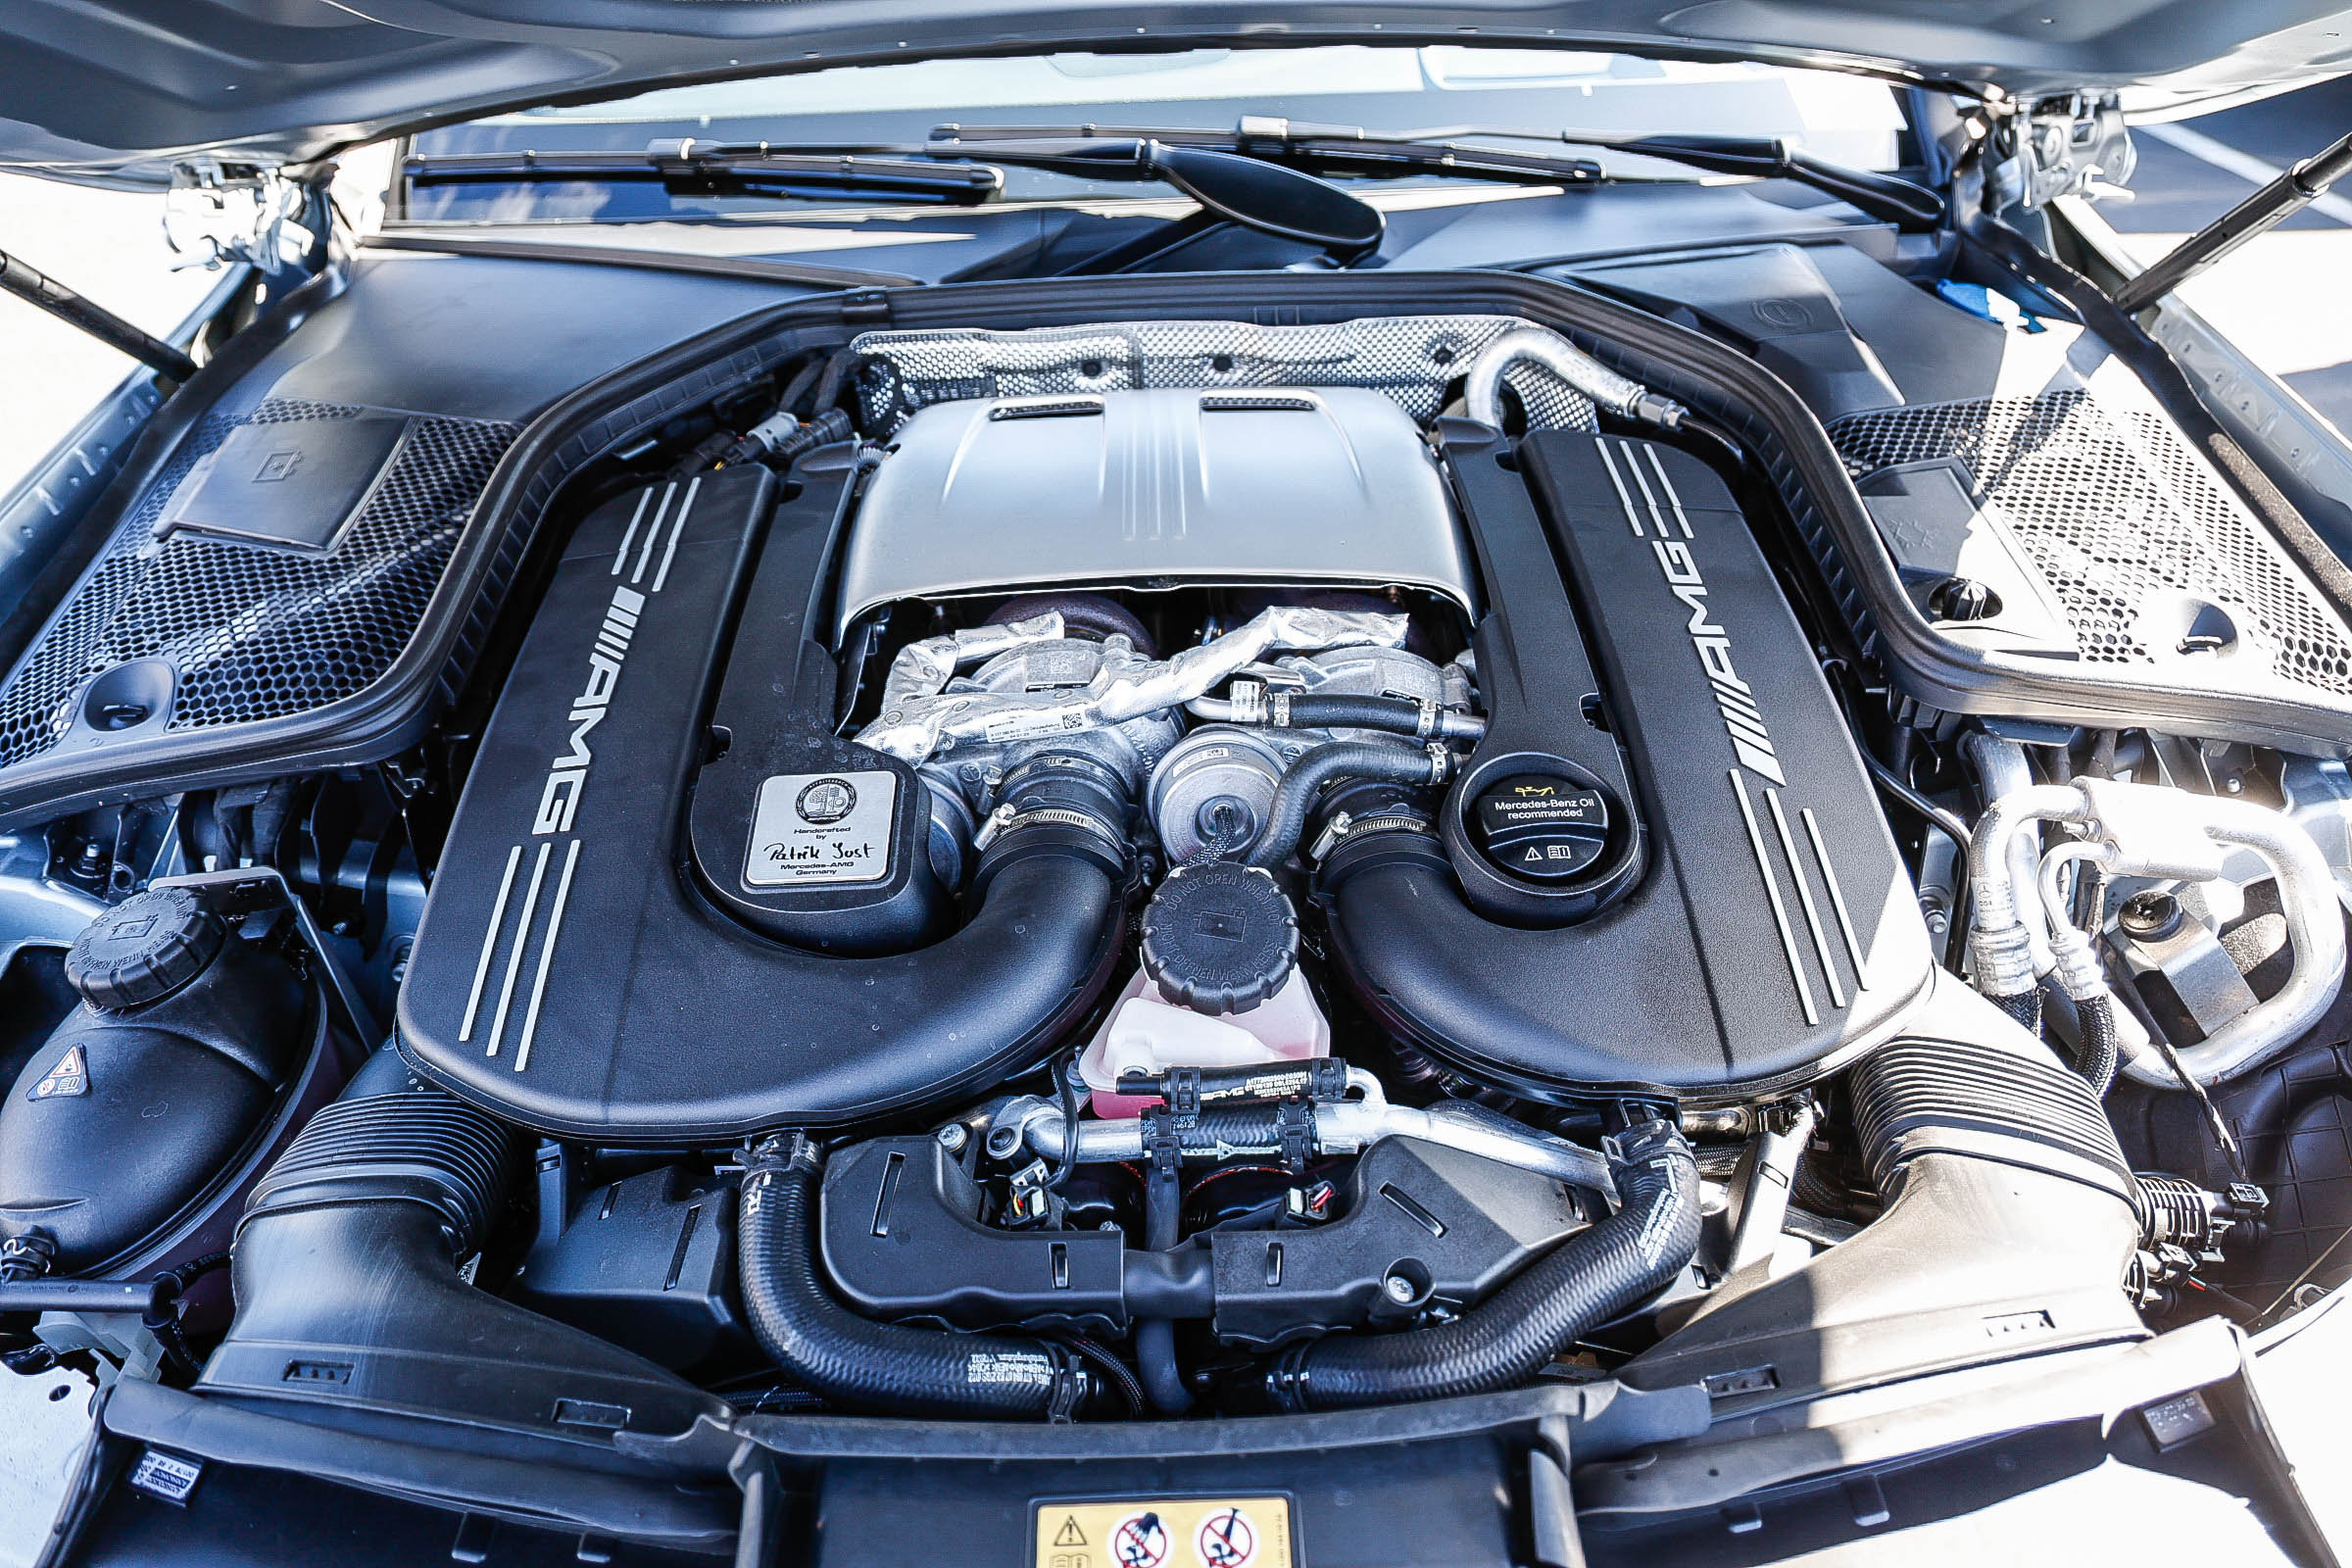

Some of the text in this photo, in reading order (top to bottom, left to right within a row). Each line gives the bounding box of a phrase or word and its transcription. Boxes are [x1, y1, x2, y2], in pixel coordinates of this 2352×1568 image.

[1652, 540, 1751, 696] AMG
[532, 652, 621, 835] AMG
[1494, 799, 1594, 810] Mercedes-Benz Oil
[1507, 808, 1584, 819] recommended
[780, 861, 855, 870] Mercedes-AMG
[1166, 894, 1182, 910] DO
[1180, 877, 1201, 897] NOT
[1205, 871, 1238, 886] OPEN
[1241, 877, 1272, 905] WHEN
[137, 892, 164, 905] OPEN
